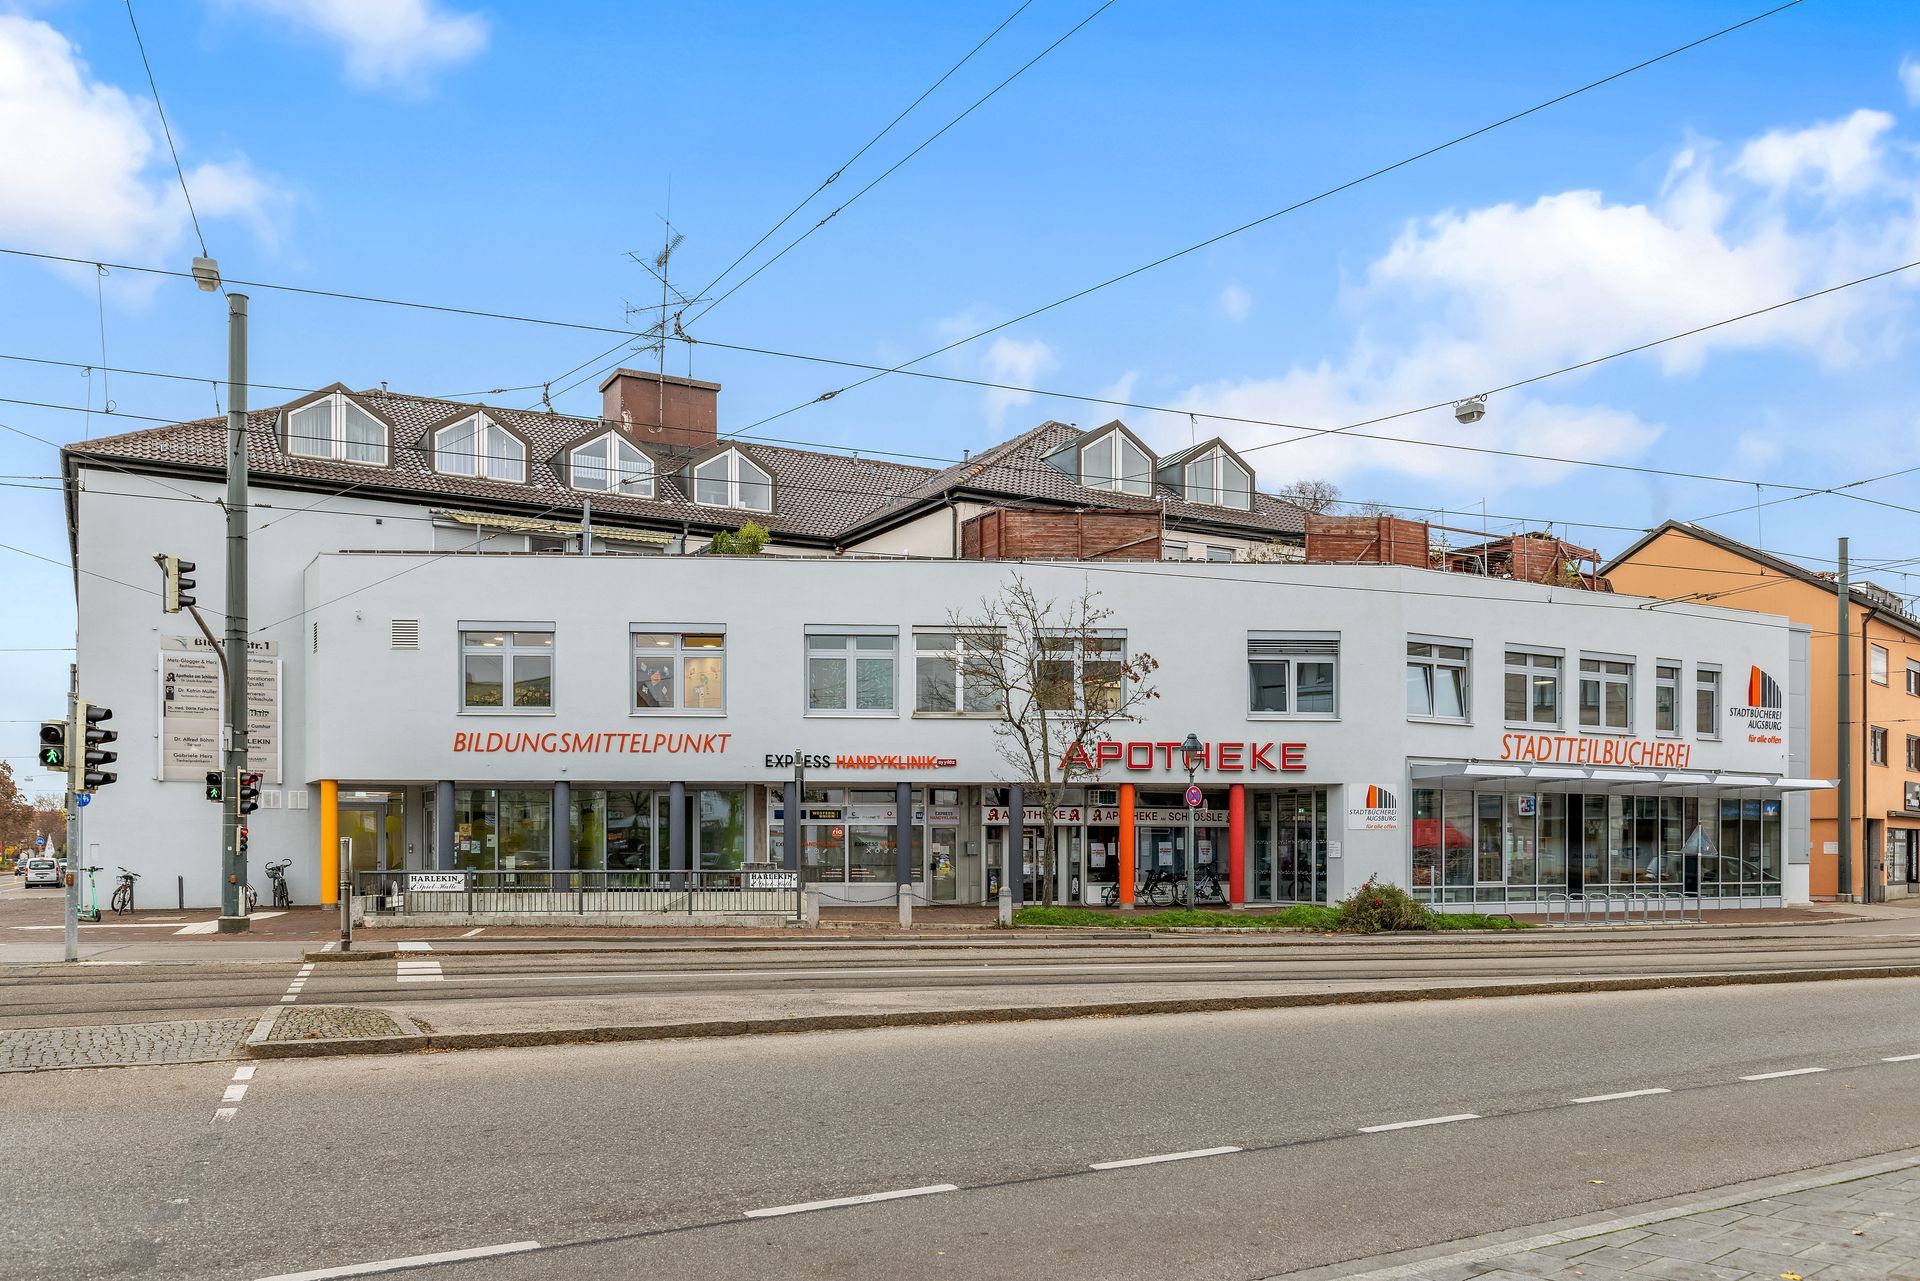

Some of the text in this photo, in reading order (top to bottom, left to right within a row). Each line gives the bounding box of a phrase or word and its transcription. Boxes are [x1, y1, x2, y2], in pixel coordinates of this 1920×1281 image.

[1730, 707, 1782, 719] STADTBÜCHEREI
[1748, 720, 1782, 730] AUGSBURG
[453, 732, 732, 753] BILDUNGSMITTELPUNKT
[1757, 735, 1767, 743] alle
[1500, 734, 1690, 767] STADTTEILBÜCHEREI
[766, 755, 938, 769] EXPESS HANDYKLINIK
